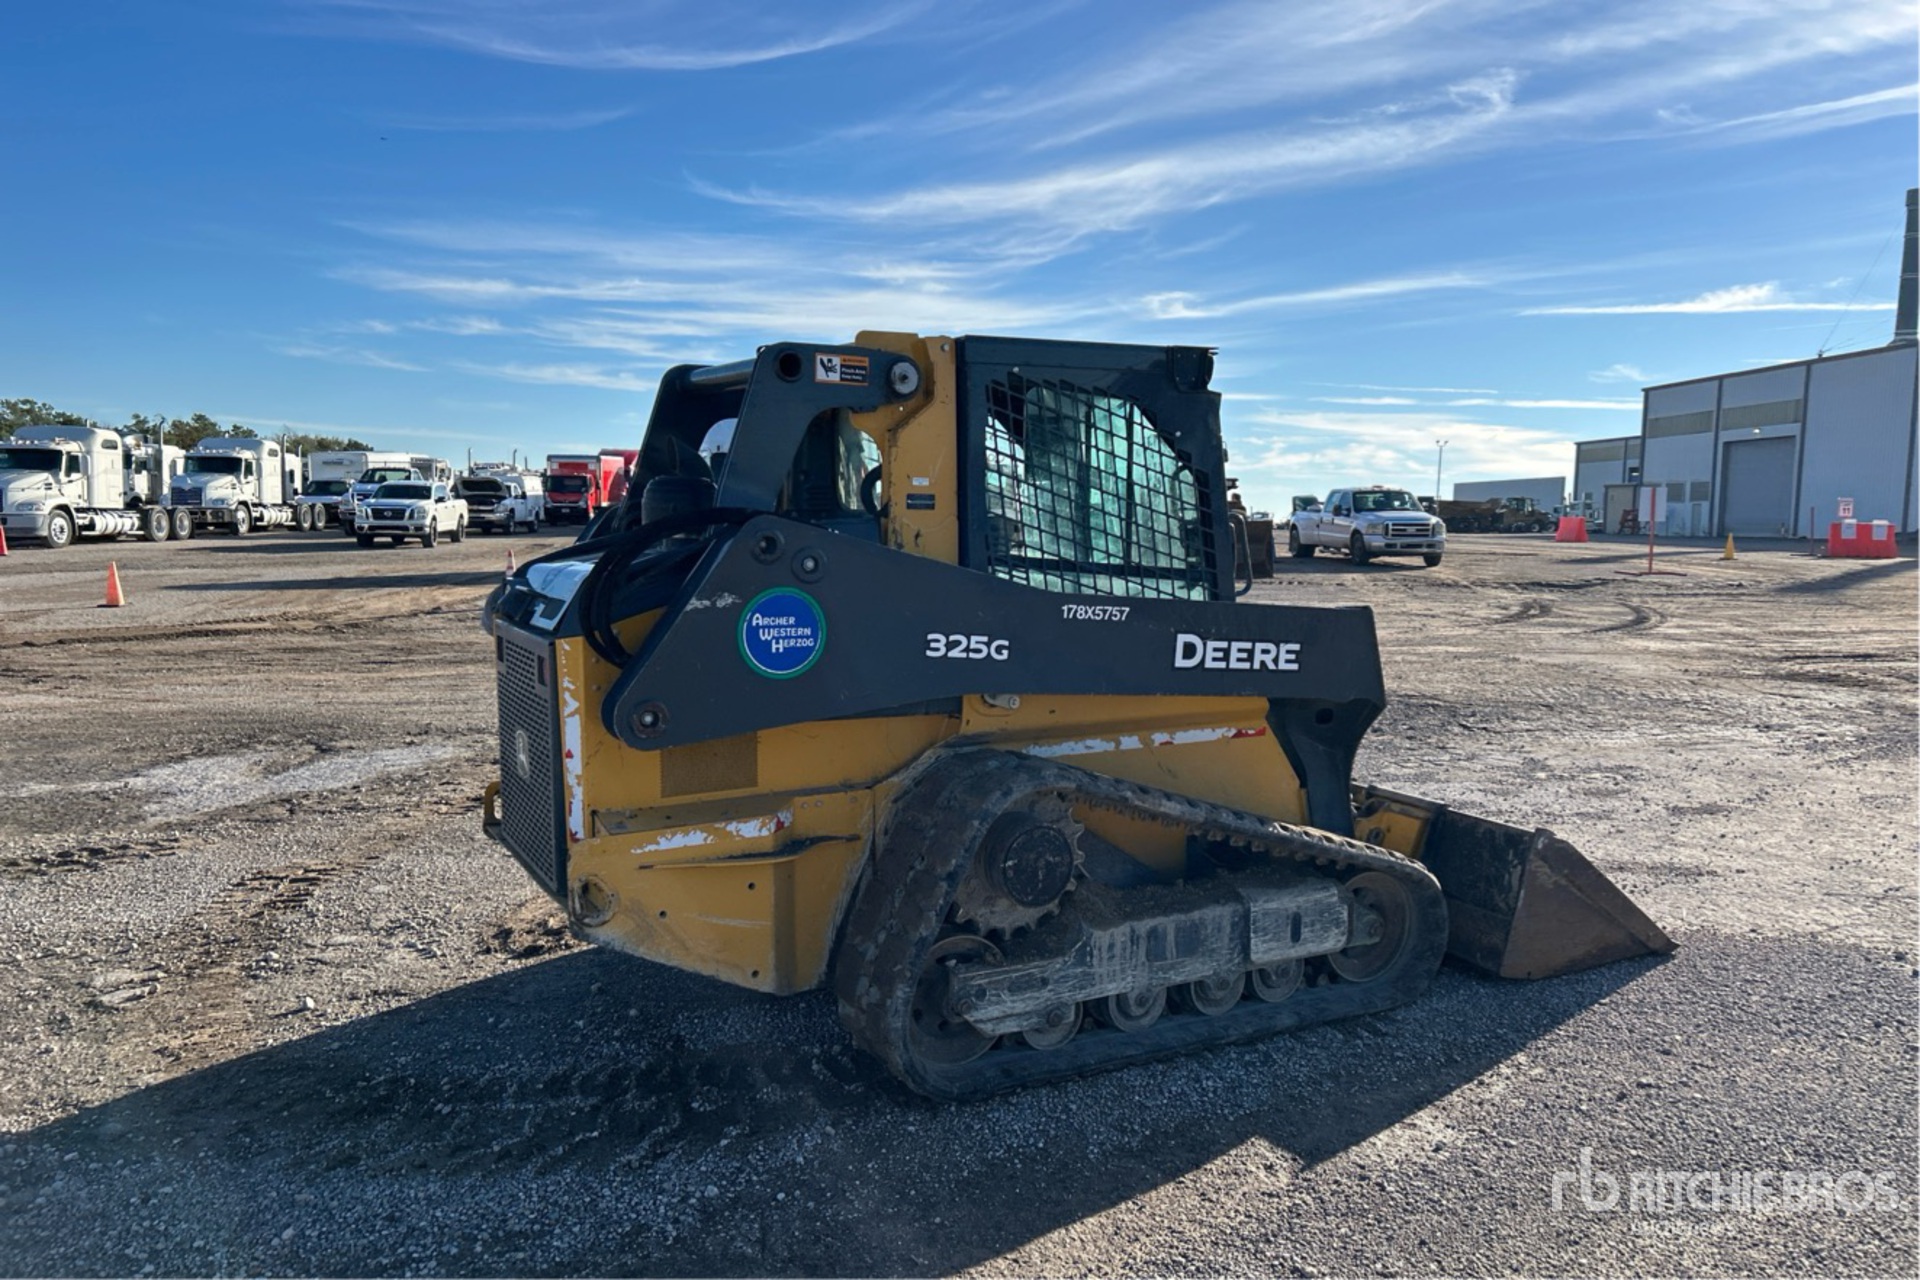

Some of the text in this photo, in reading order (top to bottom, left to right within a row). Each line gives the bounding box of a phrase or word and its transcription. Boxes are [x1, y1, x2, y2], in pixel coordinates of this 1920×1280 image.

[752, 613, 795, 626] ARCHER
[1062, 605, 1130, 621] 178X5757
[759, 627, 811, 640] WESTERN
[772, 638, 814, 653] HERZOG
[926, 633, 1009, 660] 325G
[1174, 633, 1300, 671] DEERE
